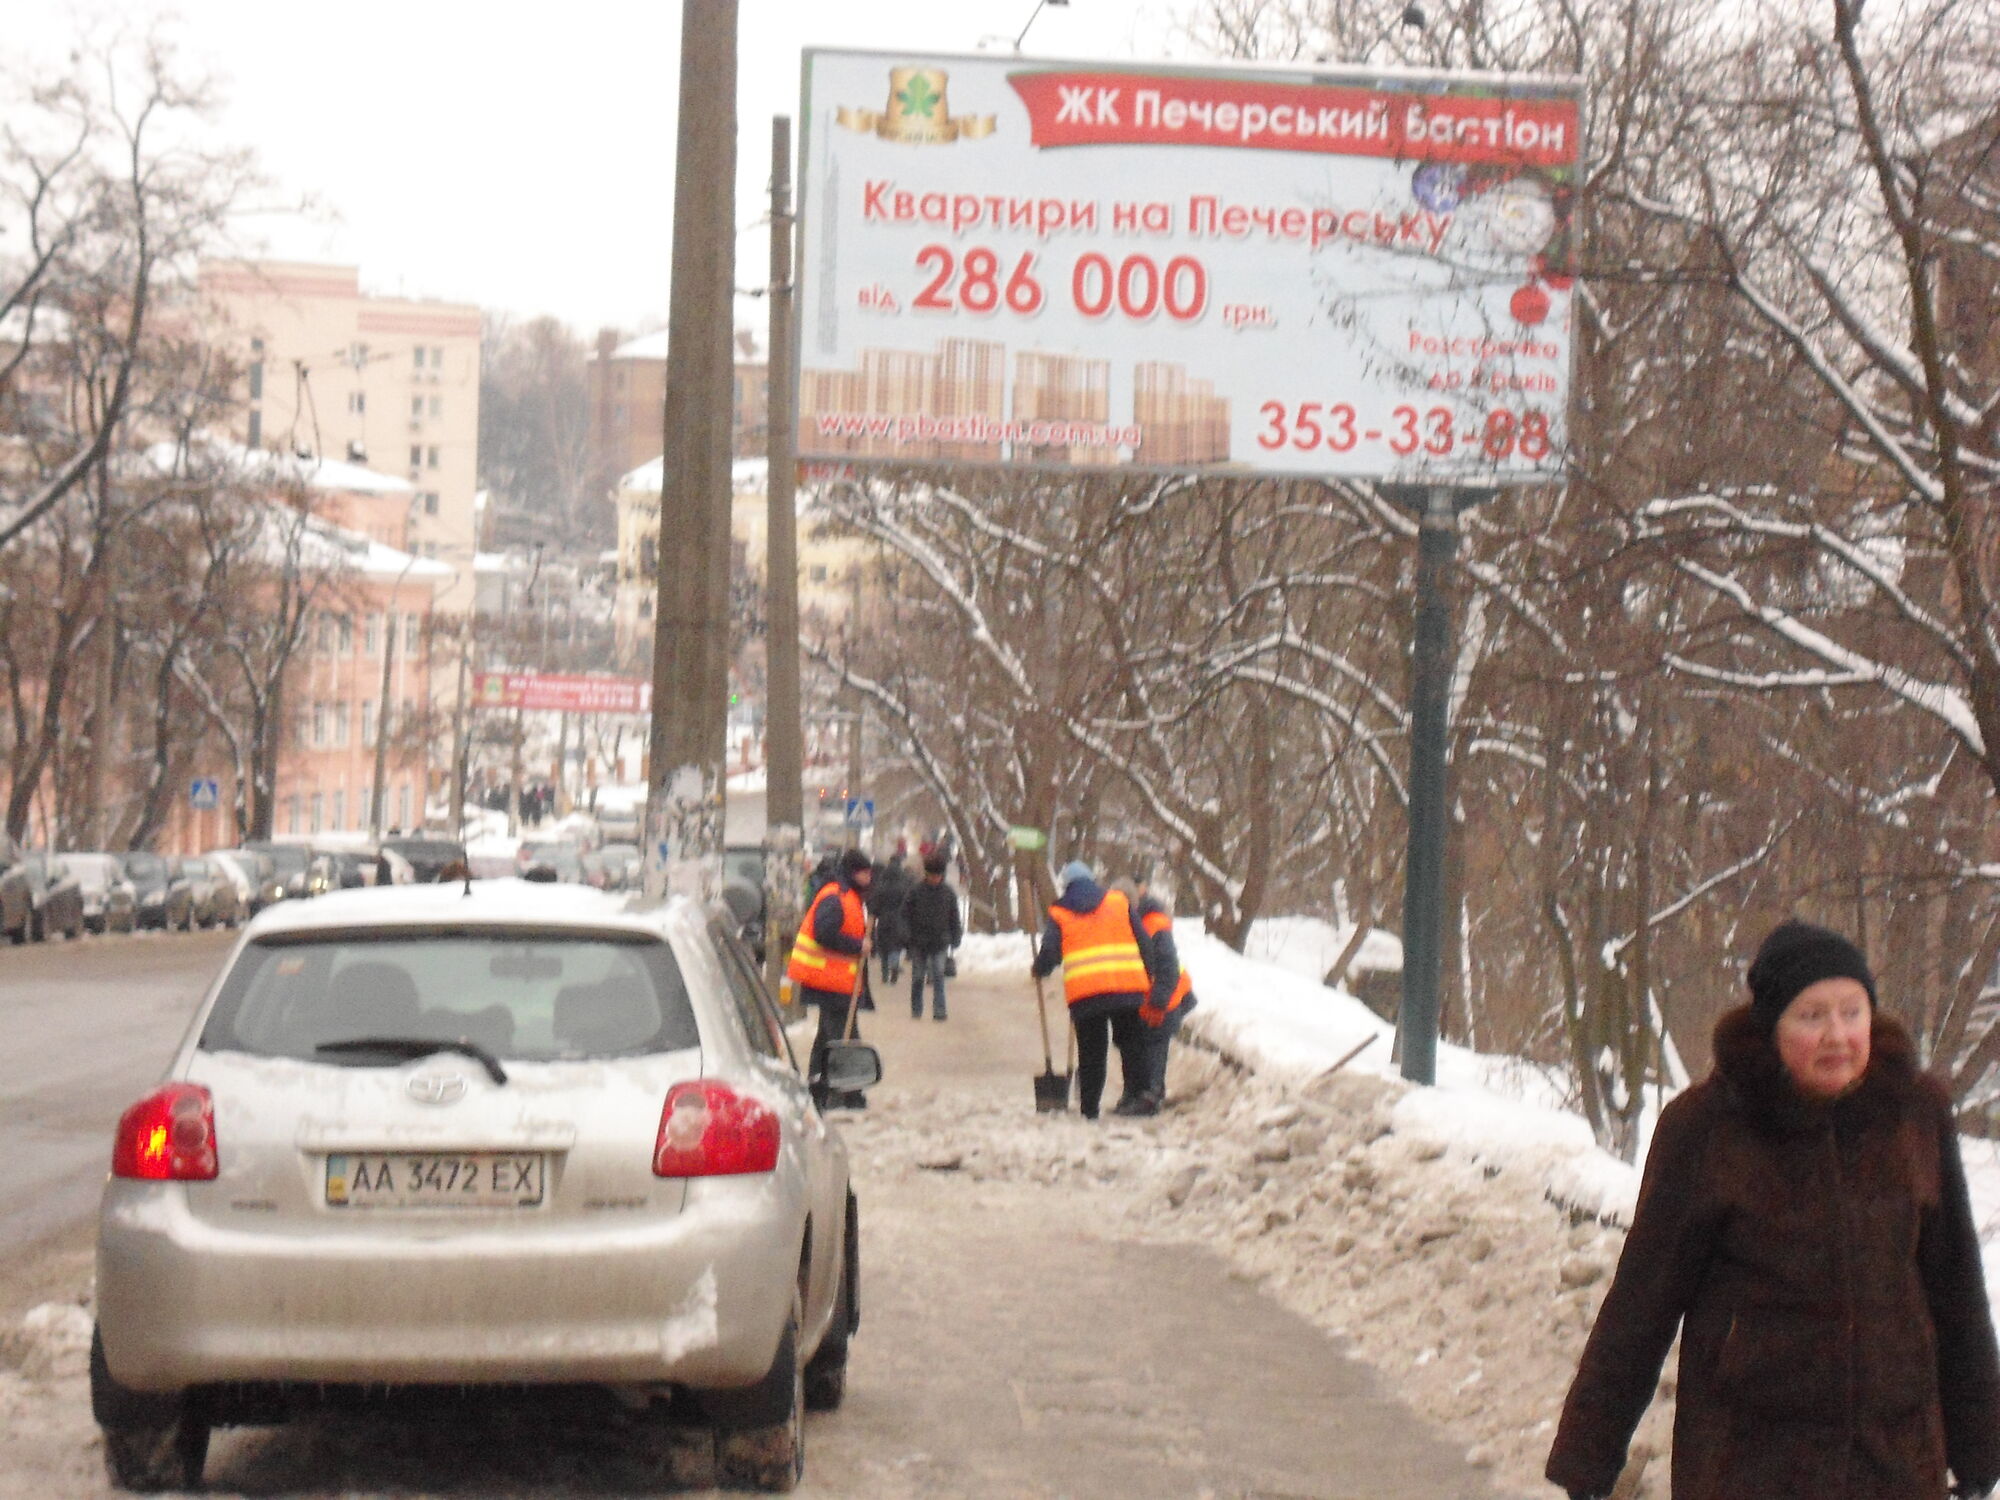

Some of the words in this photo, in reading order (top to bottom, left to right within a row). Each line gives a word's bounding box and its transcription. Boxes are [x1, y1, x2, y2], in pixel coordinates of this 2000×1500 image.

[1055, 84, 1121, 126] ЖК
[1134, 88, 1390, 142] Печерський
[1404, 101, 1566, 152] Бастіон
[863, 179, 1097, 236] Квартири
[1112, 202, 1171, 233] на
[1188, 194, 1453, 255] Печерську
[911, 243, 1044, 316] 286
[1071, 252, 1208, 322] 000
[1256, 399, 1551, 461] 353-33-88
[407, 1159, 479, 1192] 3472
